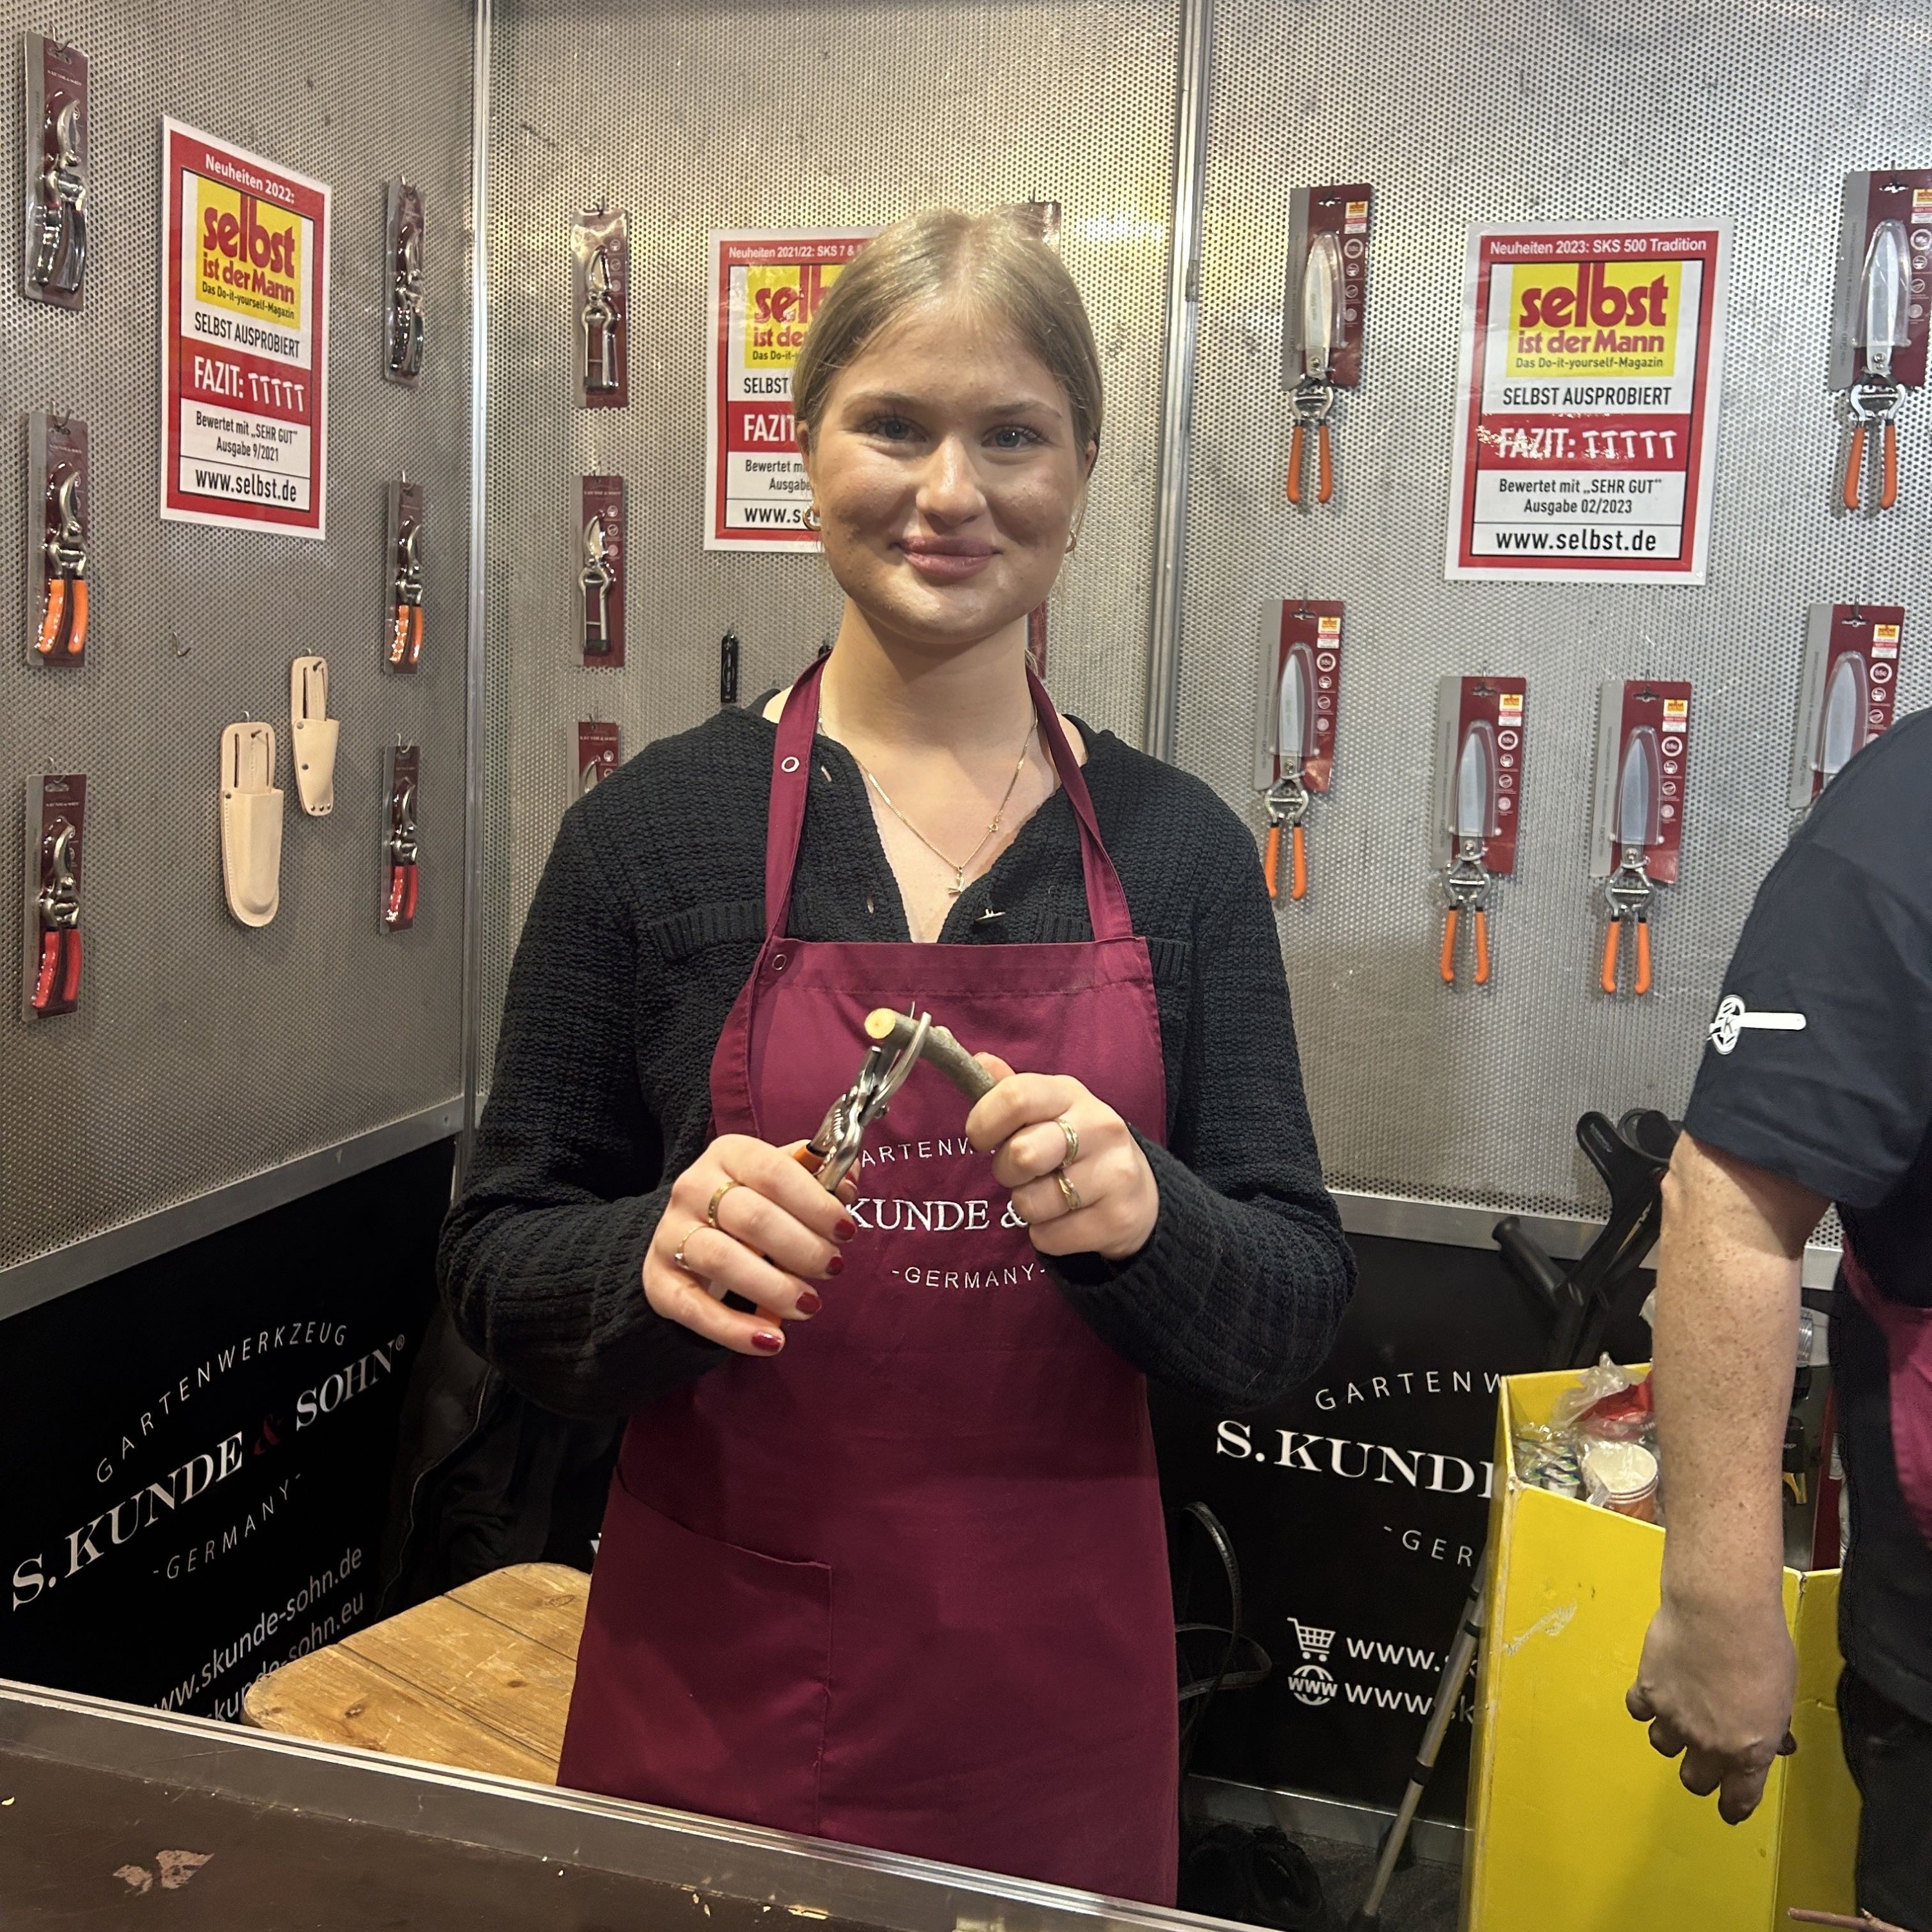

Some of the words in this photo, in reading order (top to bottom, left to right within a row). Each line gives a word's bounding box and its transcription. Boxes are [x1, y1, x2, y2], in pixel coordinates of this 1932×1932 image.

[205, 153, 263, 191] Neuheiten
[265, 180, 295, 204] 2022:
[204, 194, 295, 279] selbst
[1490, 240, 1553, 256] Neuheiten
[1555, 240, 1590, 254] 2023:
[1593, 238, 1621, 253] SKS
[1624, 238, 1647, 252] 500
[1649, 237, 1707, 252] Tradition
[728, 247, 776, 258] Neuheiten
[777, 245, 815, 258] 2021/22:
[817, 245, 838, 257] SKS
[839, 245, 846, 256] 7
[203, 252, 220, 281] ist
[222, 260, 251, 290] der
[251, 268, 295, 305] Mann
[202, 281, 216, 296] Das
[217, 285, 294, 319] Do-it-yourself-Magazin
[1519, 261, 1669, 328] selbst
[194, 312, 232, 340] SELBST
[234, 323, 299, 358] AUSPROBIERT
[753, 327, 773, 347] ist
[1518, 330, 1543, 354] ist
[1546, 330, 1591, 354] der
[1593, 330, 1665, 354] Mann
[752, 350, 768, 360] Das
[770, 350, 797, 361] Do-it-
[1515, 357, 1535, 368] Das
[1538, 357, 1663, 370] Do-it-yourself-Magazin
[194, 355, 243, 399] FAZIT:
[744, 377, 789, 394] SELBST
[1502, 387, 1560, 406] SELBST
[1562, 387, 1672, 406] AUSPROBIERT
[196, 411, 234, 432] Bewertet
[236, 421, 249, 436] mit
[216, 437, 251, 458] Ausgabe
[253, 444, 279, 462] 9/2021
[1498, 427, 1576, 459] FAZIT:
[745, 459, 791, 473] Bewertet
[793, 462, 805, 473] m
[195, 469, 297, 502] www.selbst.de
[1499, 478, 1556, 494] Bewertet
[1559, 478, 1580, 494] mit
[1524, 498, 1578, 515] Ausgabe
[1580, 498, 1633, 515] 02/2023
[1495, 528, 1656, 552] www.selbst.de
[846, 1198, 990, 1231] KUNDE
[96, 1321, 347, 1483] GARTENWERKZEUG
[154, 1547, 362, 1712] ww.skunde-sohn.de
